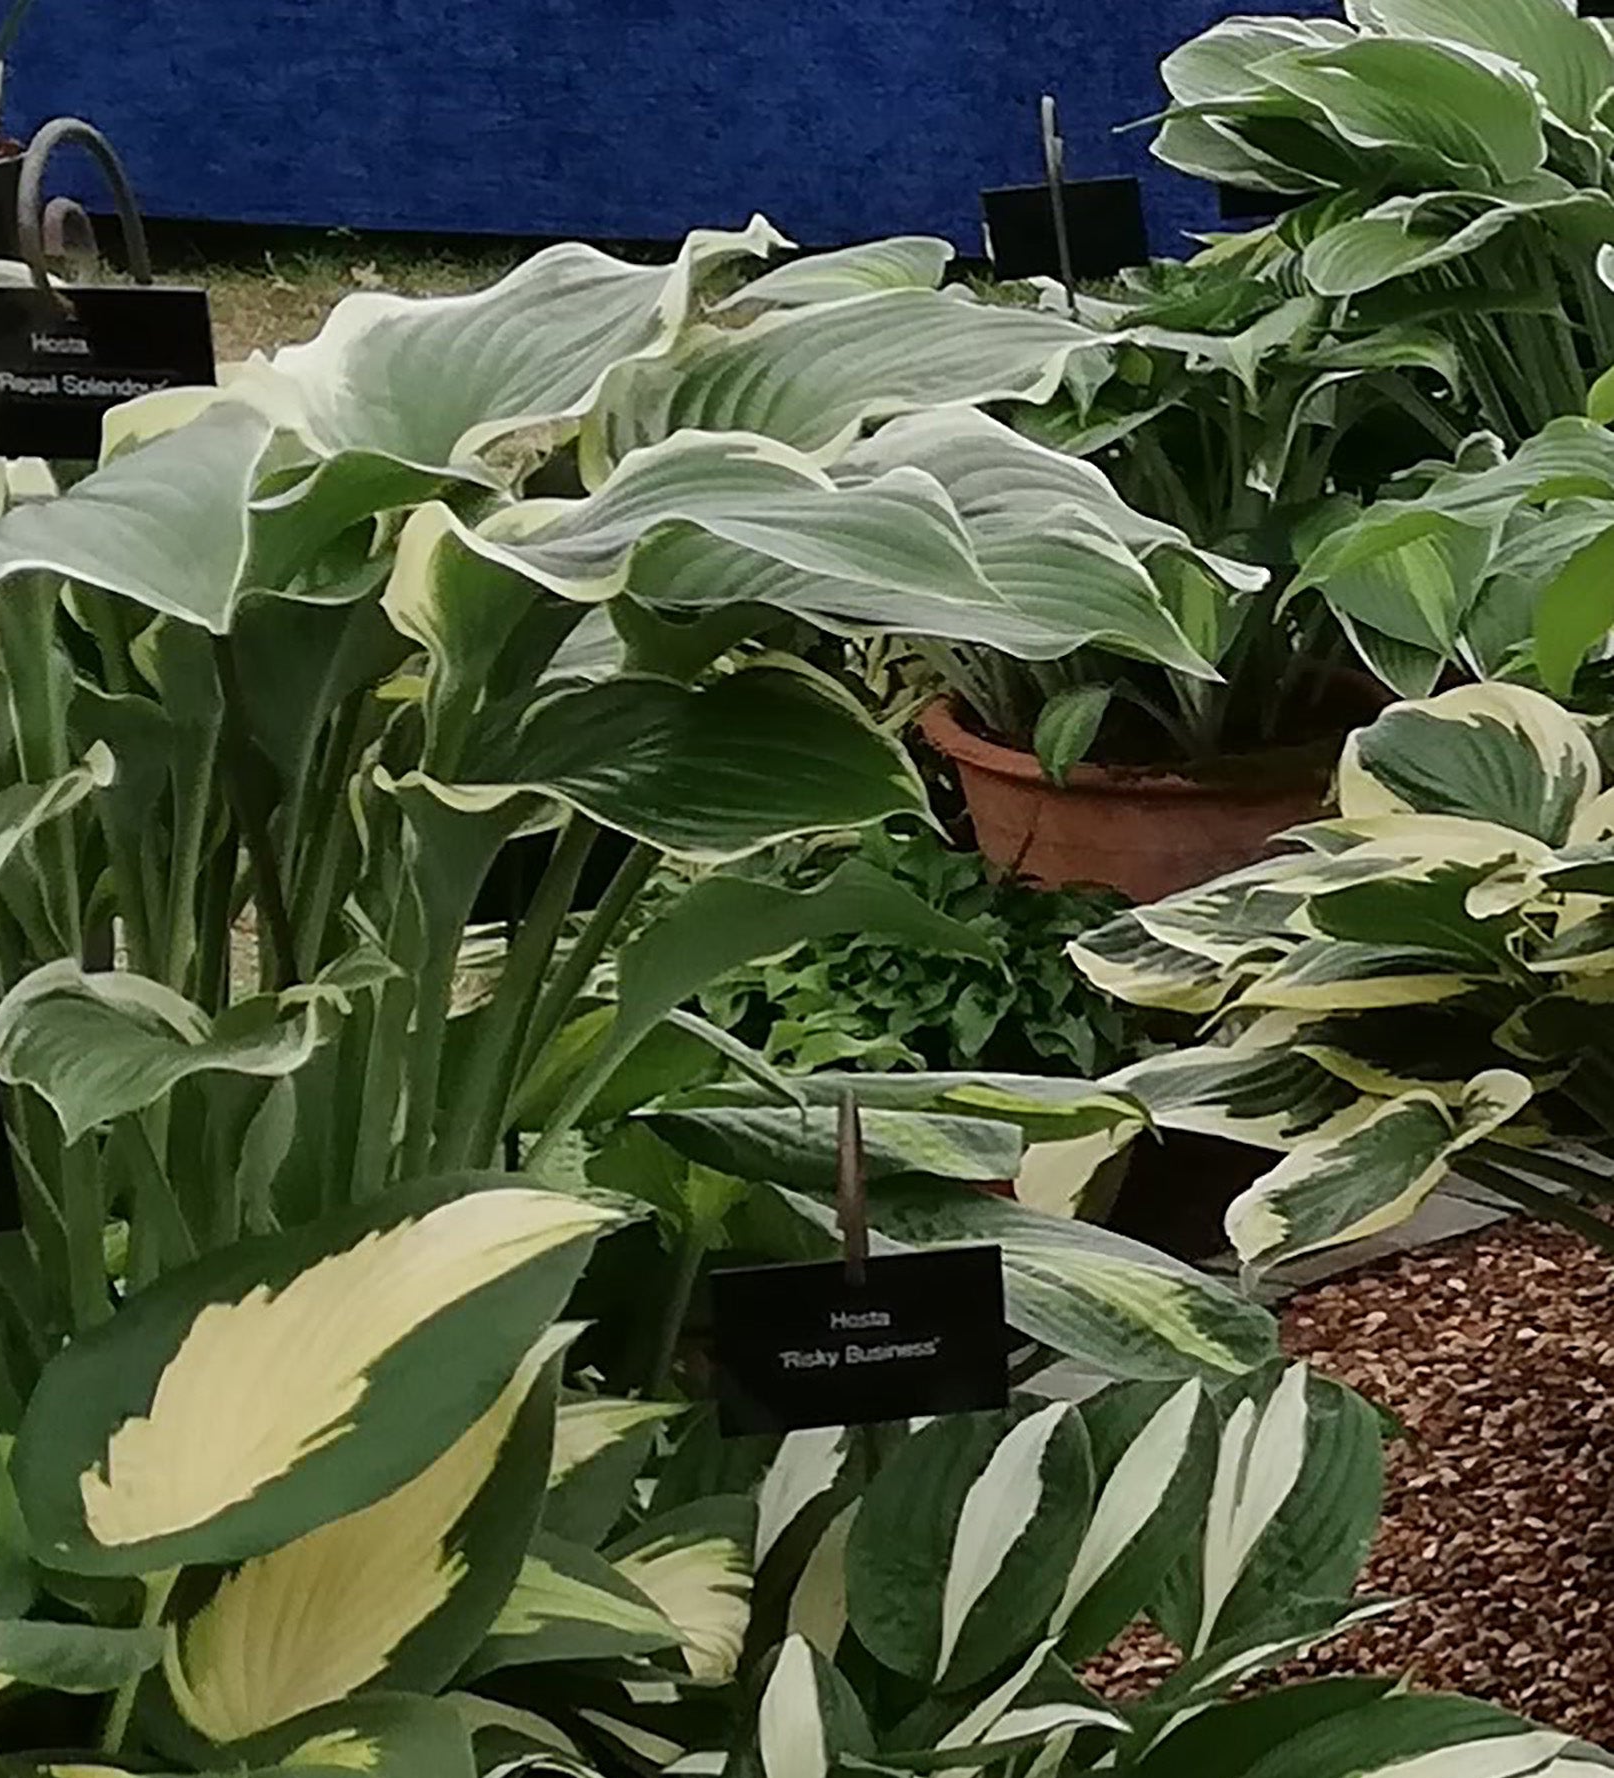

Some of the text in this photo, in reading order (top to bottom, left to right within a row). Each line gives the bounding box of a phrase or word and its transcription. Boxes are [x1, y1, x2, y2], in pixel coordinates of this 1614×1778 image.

[32, 332, 90, 354] Hosta
[830, 1311, 891, 1330] Hosta
[779, 1336, 941, 1370] 'Risky Business'
